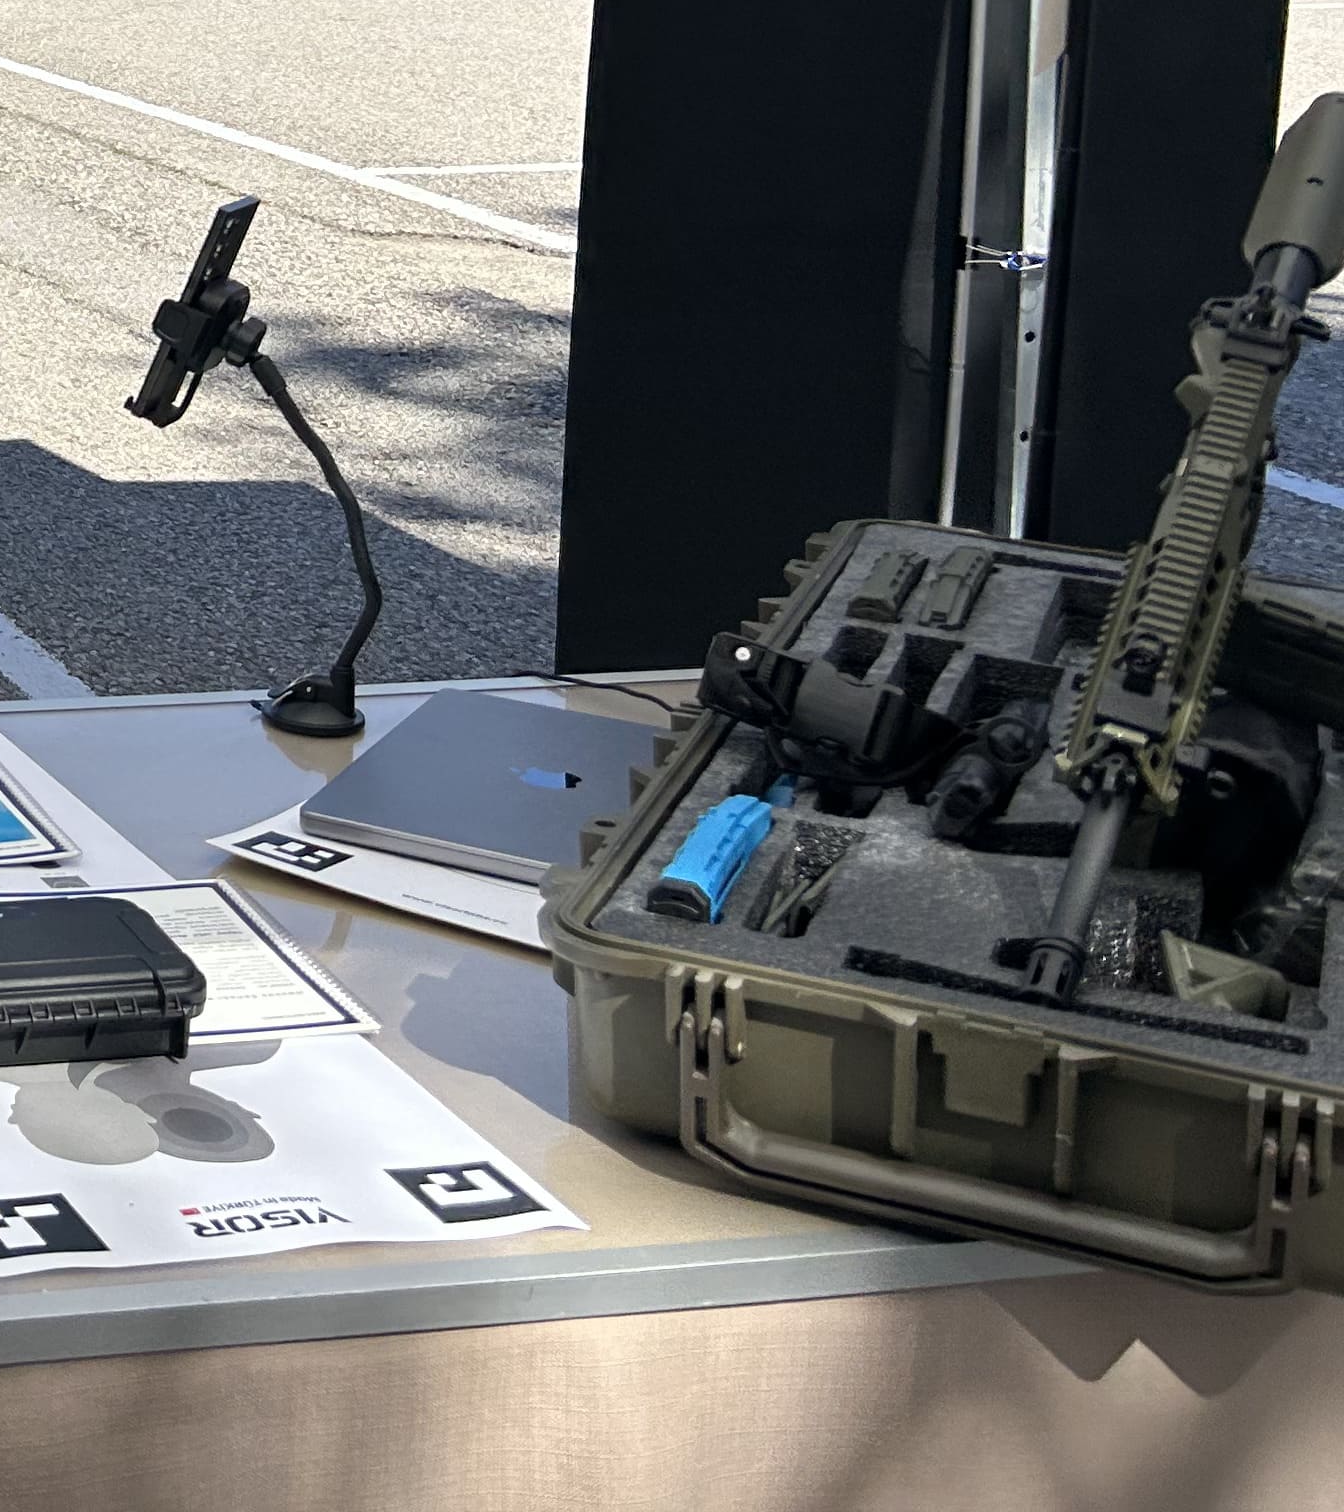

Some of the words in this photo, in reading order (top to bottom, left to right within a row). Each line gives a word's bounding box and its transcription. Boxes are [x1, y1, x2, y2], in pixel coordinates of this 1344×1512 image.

[202, 1199, 260, 1213] TÜRKİYE
[280, 1195, 321, 1205] Made
[185, 1206, 352, 1239] VISOR
